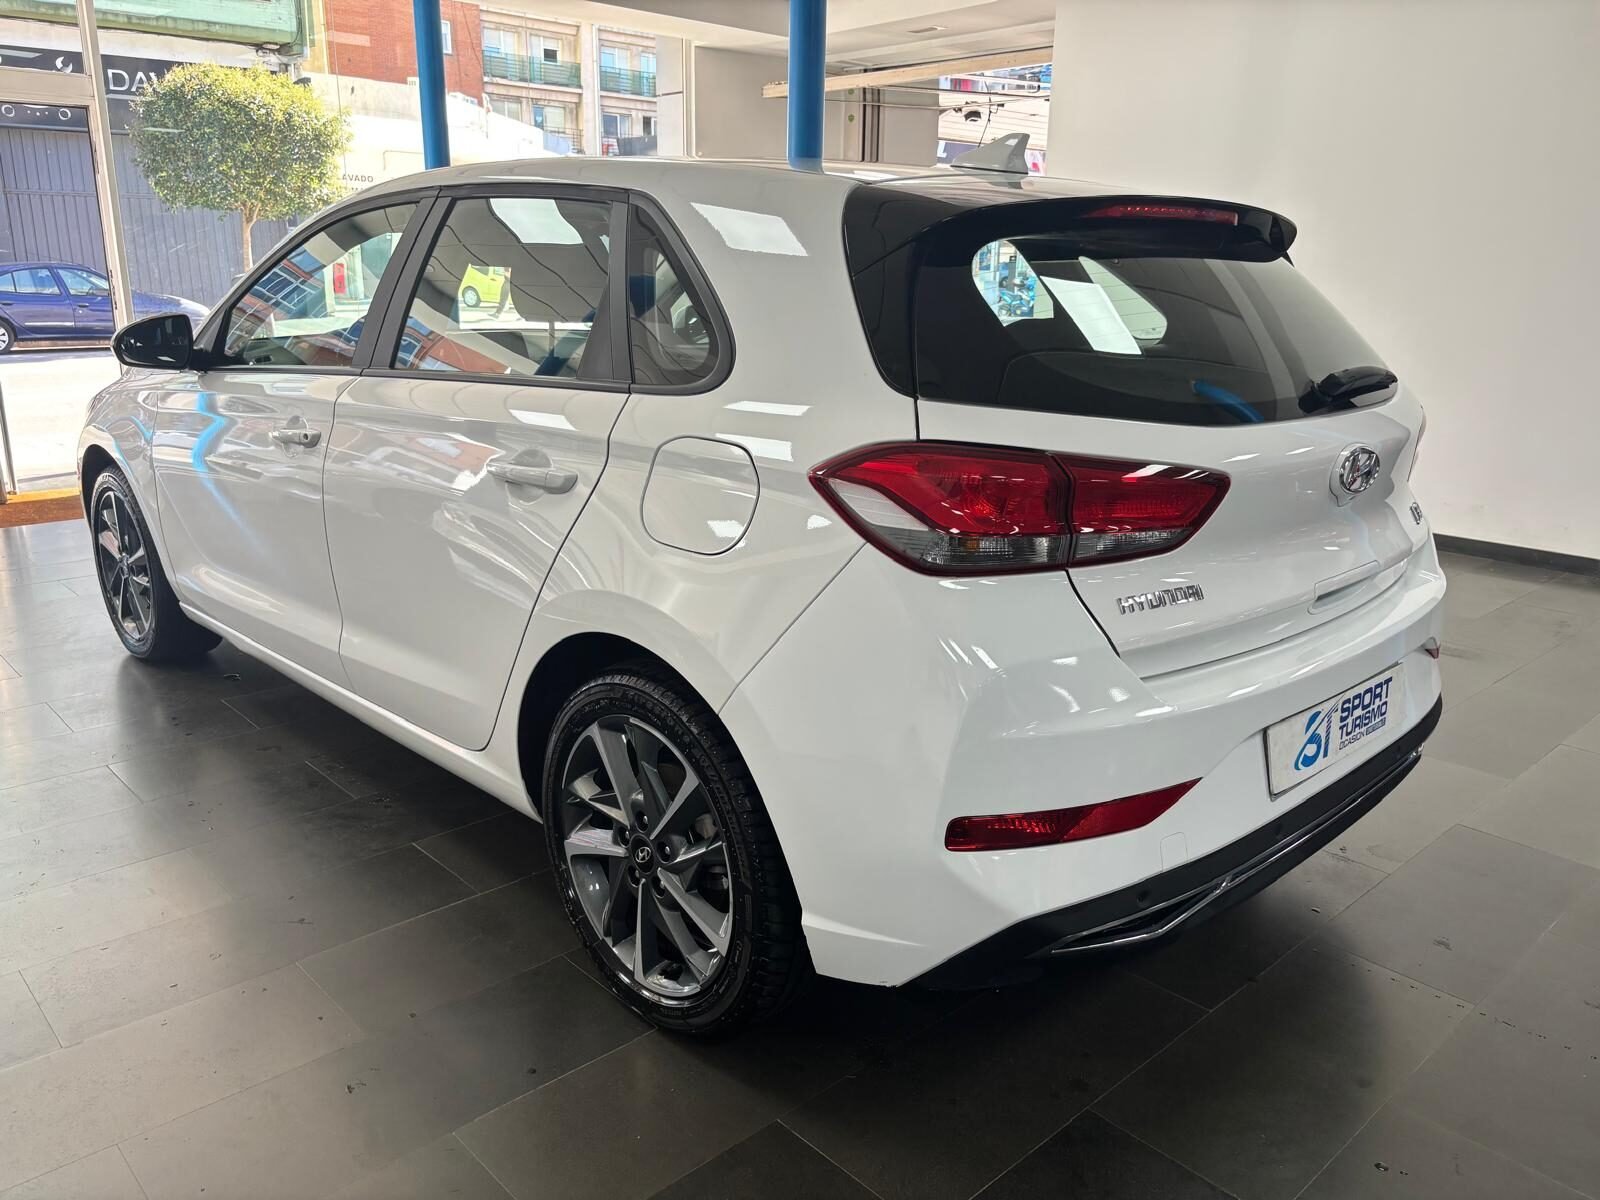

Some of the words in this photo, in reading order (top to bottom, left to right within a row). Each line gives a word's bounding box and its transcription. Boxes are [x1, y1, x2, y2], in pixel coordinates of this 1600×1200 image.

[1116, 584, 1205, 615] HYUNDAI
[1339, 700, 1388, 740] TURISMO
[1340, 676, 1393, 724] SPORT
